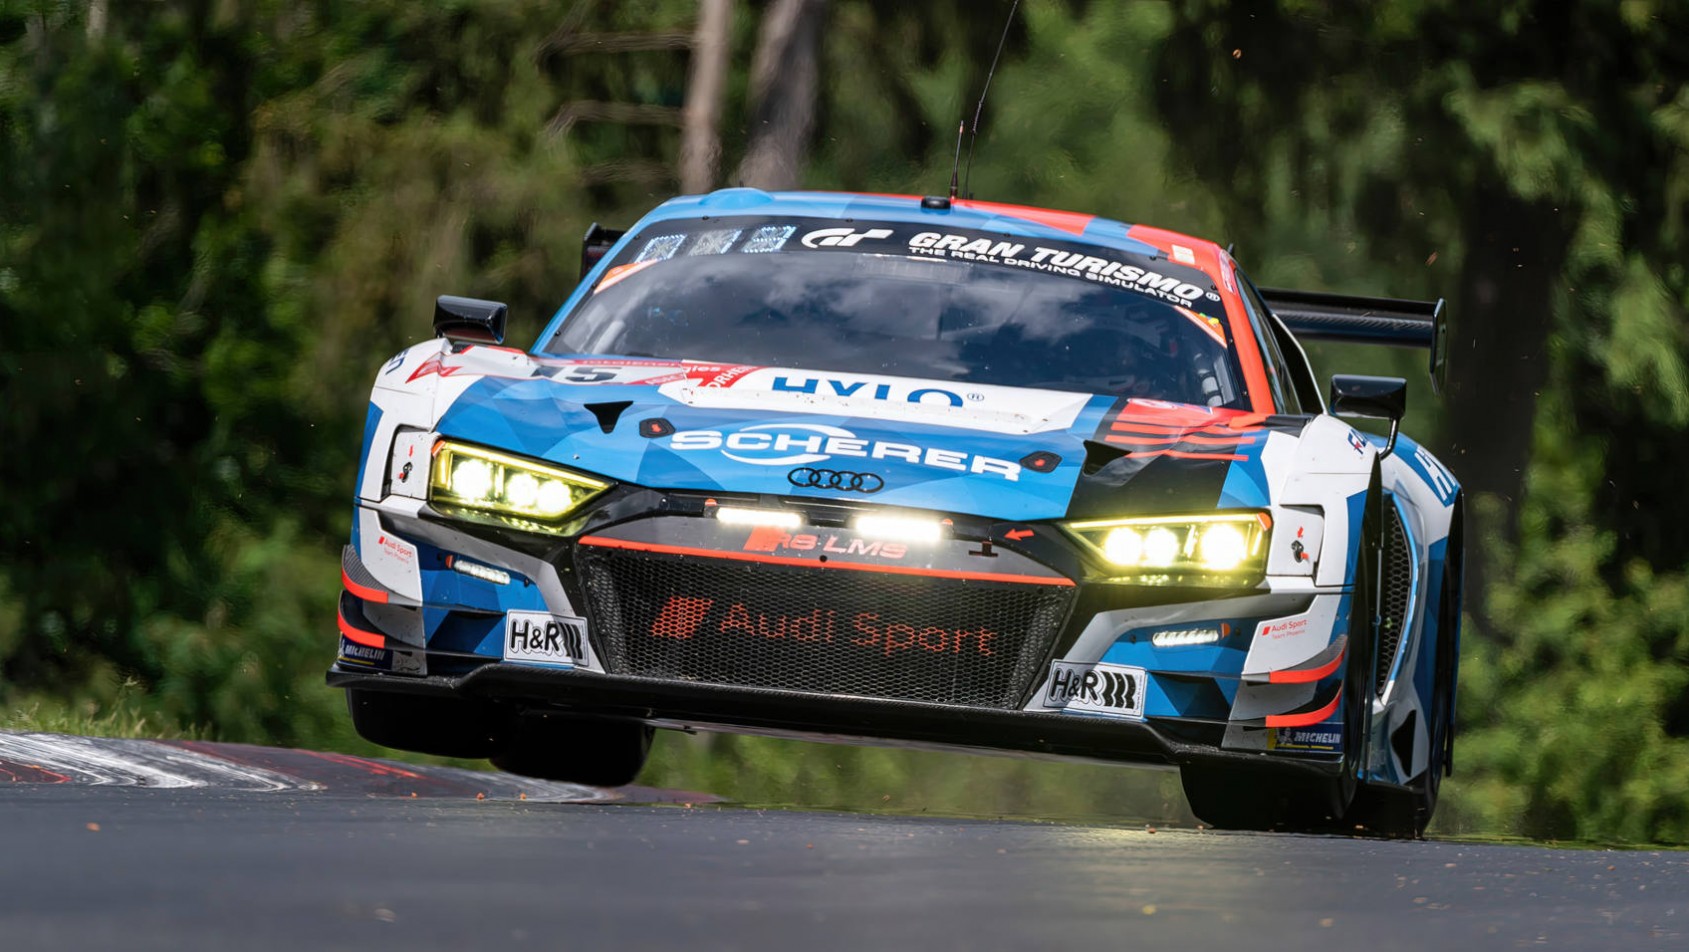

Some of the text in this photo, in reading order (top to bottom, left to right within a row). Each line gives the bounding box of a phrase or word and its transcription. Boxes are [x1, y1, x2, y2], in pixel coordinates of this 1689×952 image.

[908, 231, 1026, 258] GRAN
[1031, 246, 1204, 301] TURISMO
[908, 246, 1193, 309] THE REAL DRIVING SIMULATOR
[669, 429, 1022, 482] SCHERER
[822, 535, 909, 559] LMS
[510, 620, 560, 652] H&R
[719, 602, 998, 657] Audi Sport
[1272, 619, 1308, 632] Audi Sport
[344, 644, 386, 661] MICHELIN
[1050, 669, 1099, 701] H&R
[1293, 731, 1342, 744] MICHELIN
